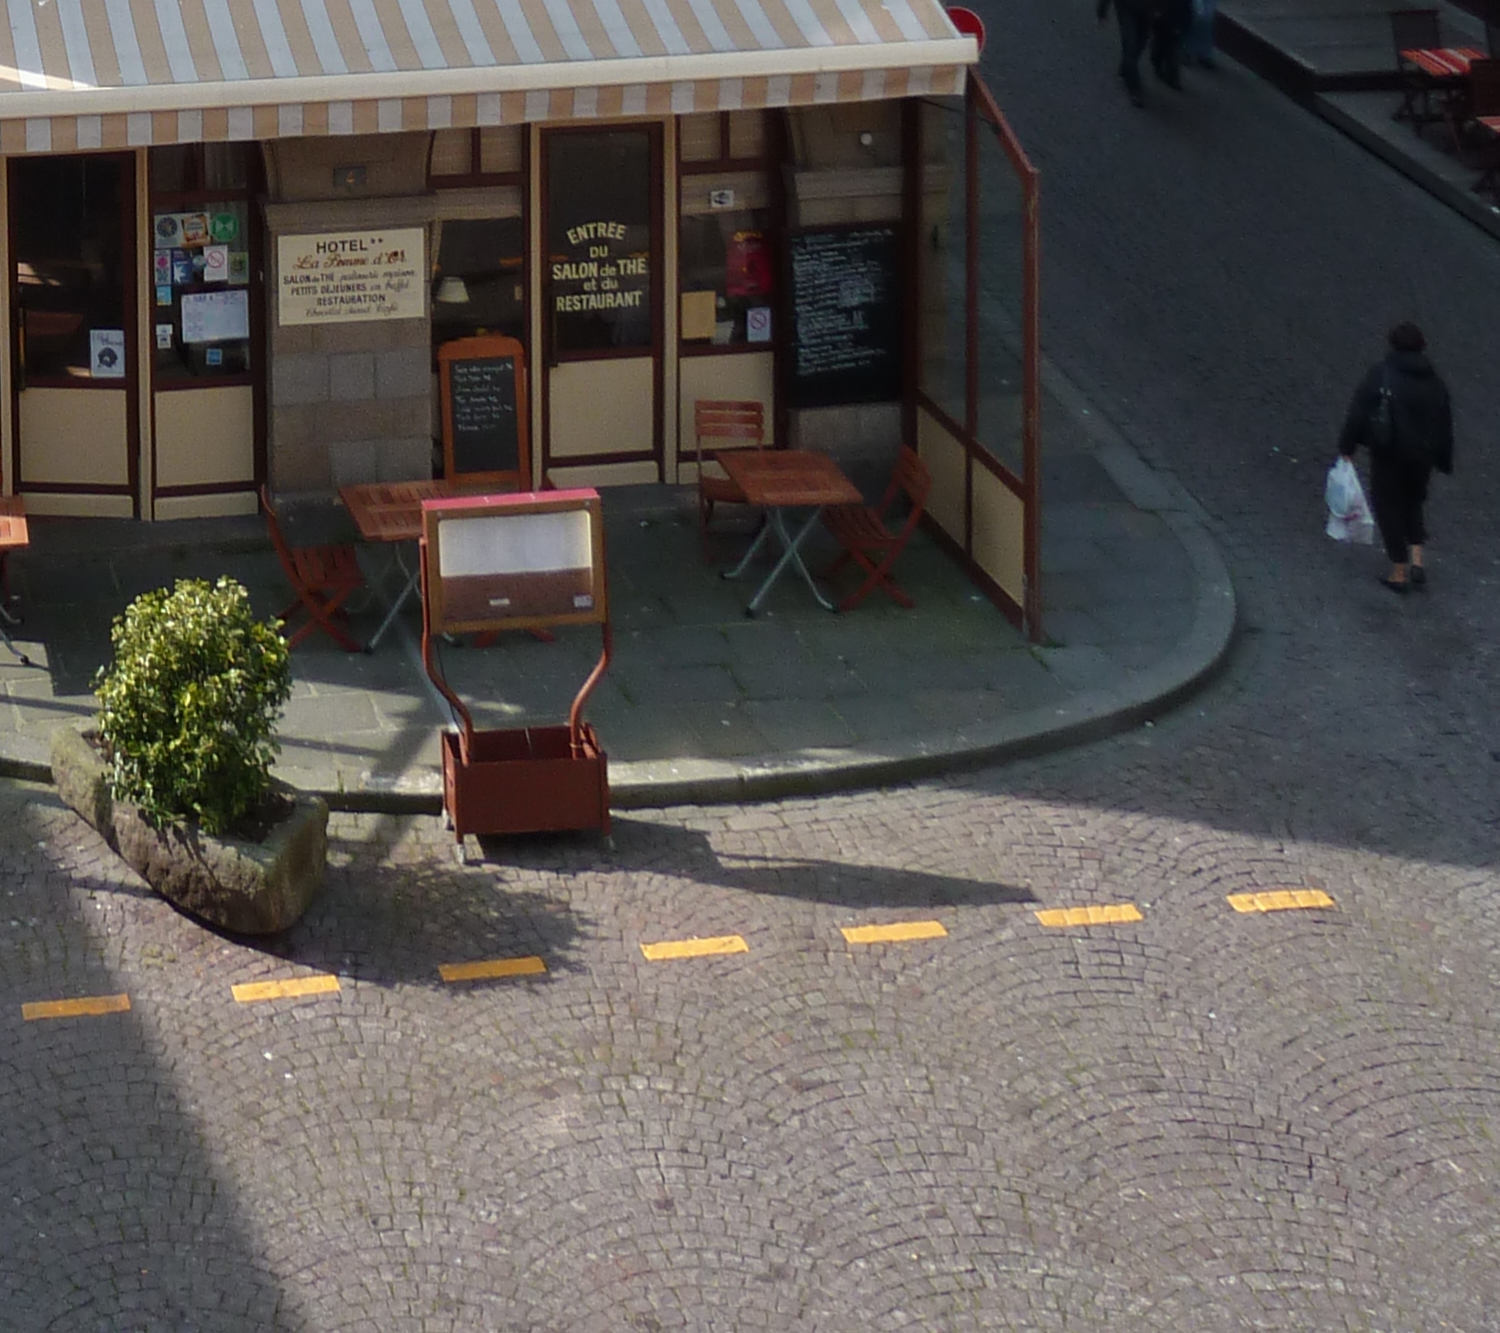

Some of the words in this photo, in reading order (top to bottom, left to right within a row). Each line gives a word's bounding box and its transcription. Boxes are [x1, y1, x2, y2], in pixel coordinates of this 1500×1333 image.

[589, 245, 608, 258] DU
[552, 261, 598, 280] SALON
[600, 263, 617, 276] de
[283, 273, 311, 285] SALON
[583, 278, 597, 291] et
[601, 277, 618, 290] du
[291, 286, 317, 296] PETITS
[316, 294, 386, 307] RESTAURATION
[556, 291, 642, 312] RESTAURANT
